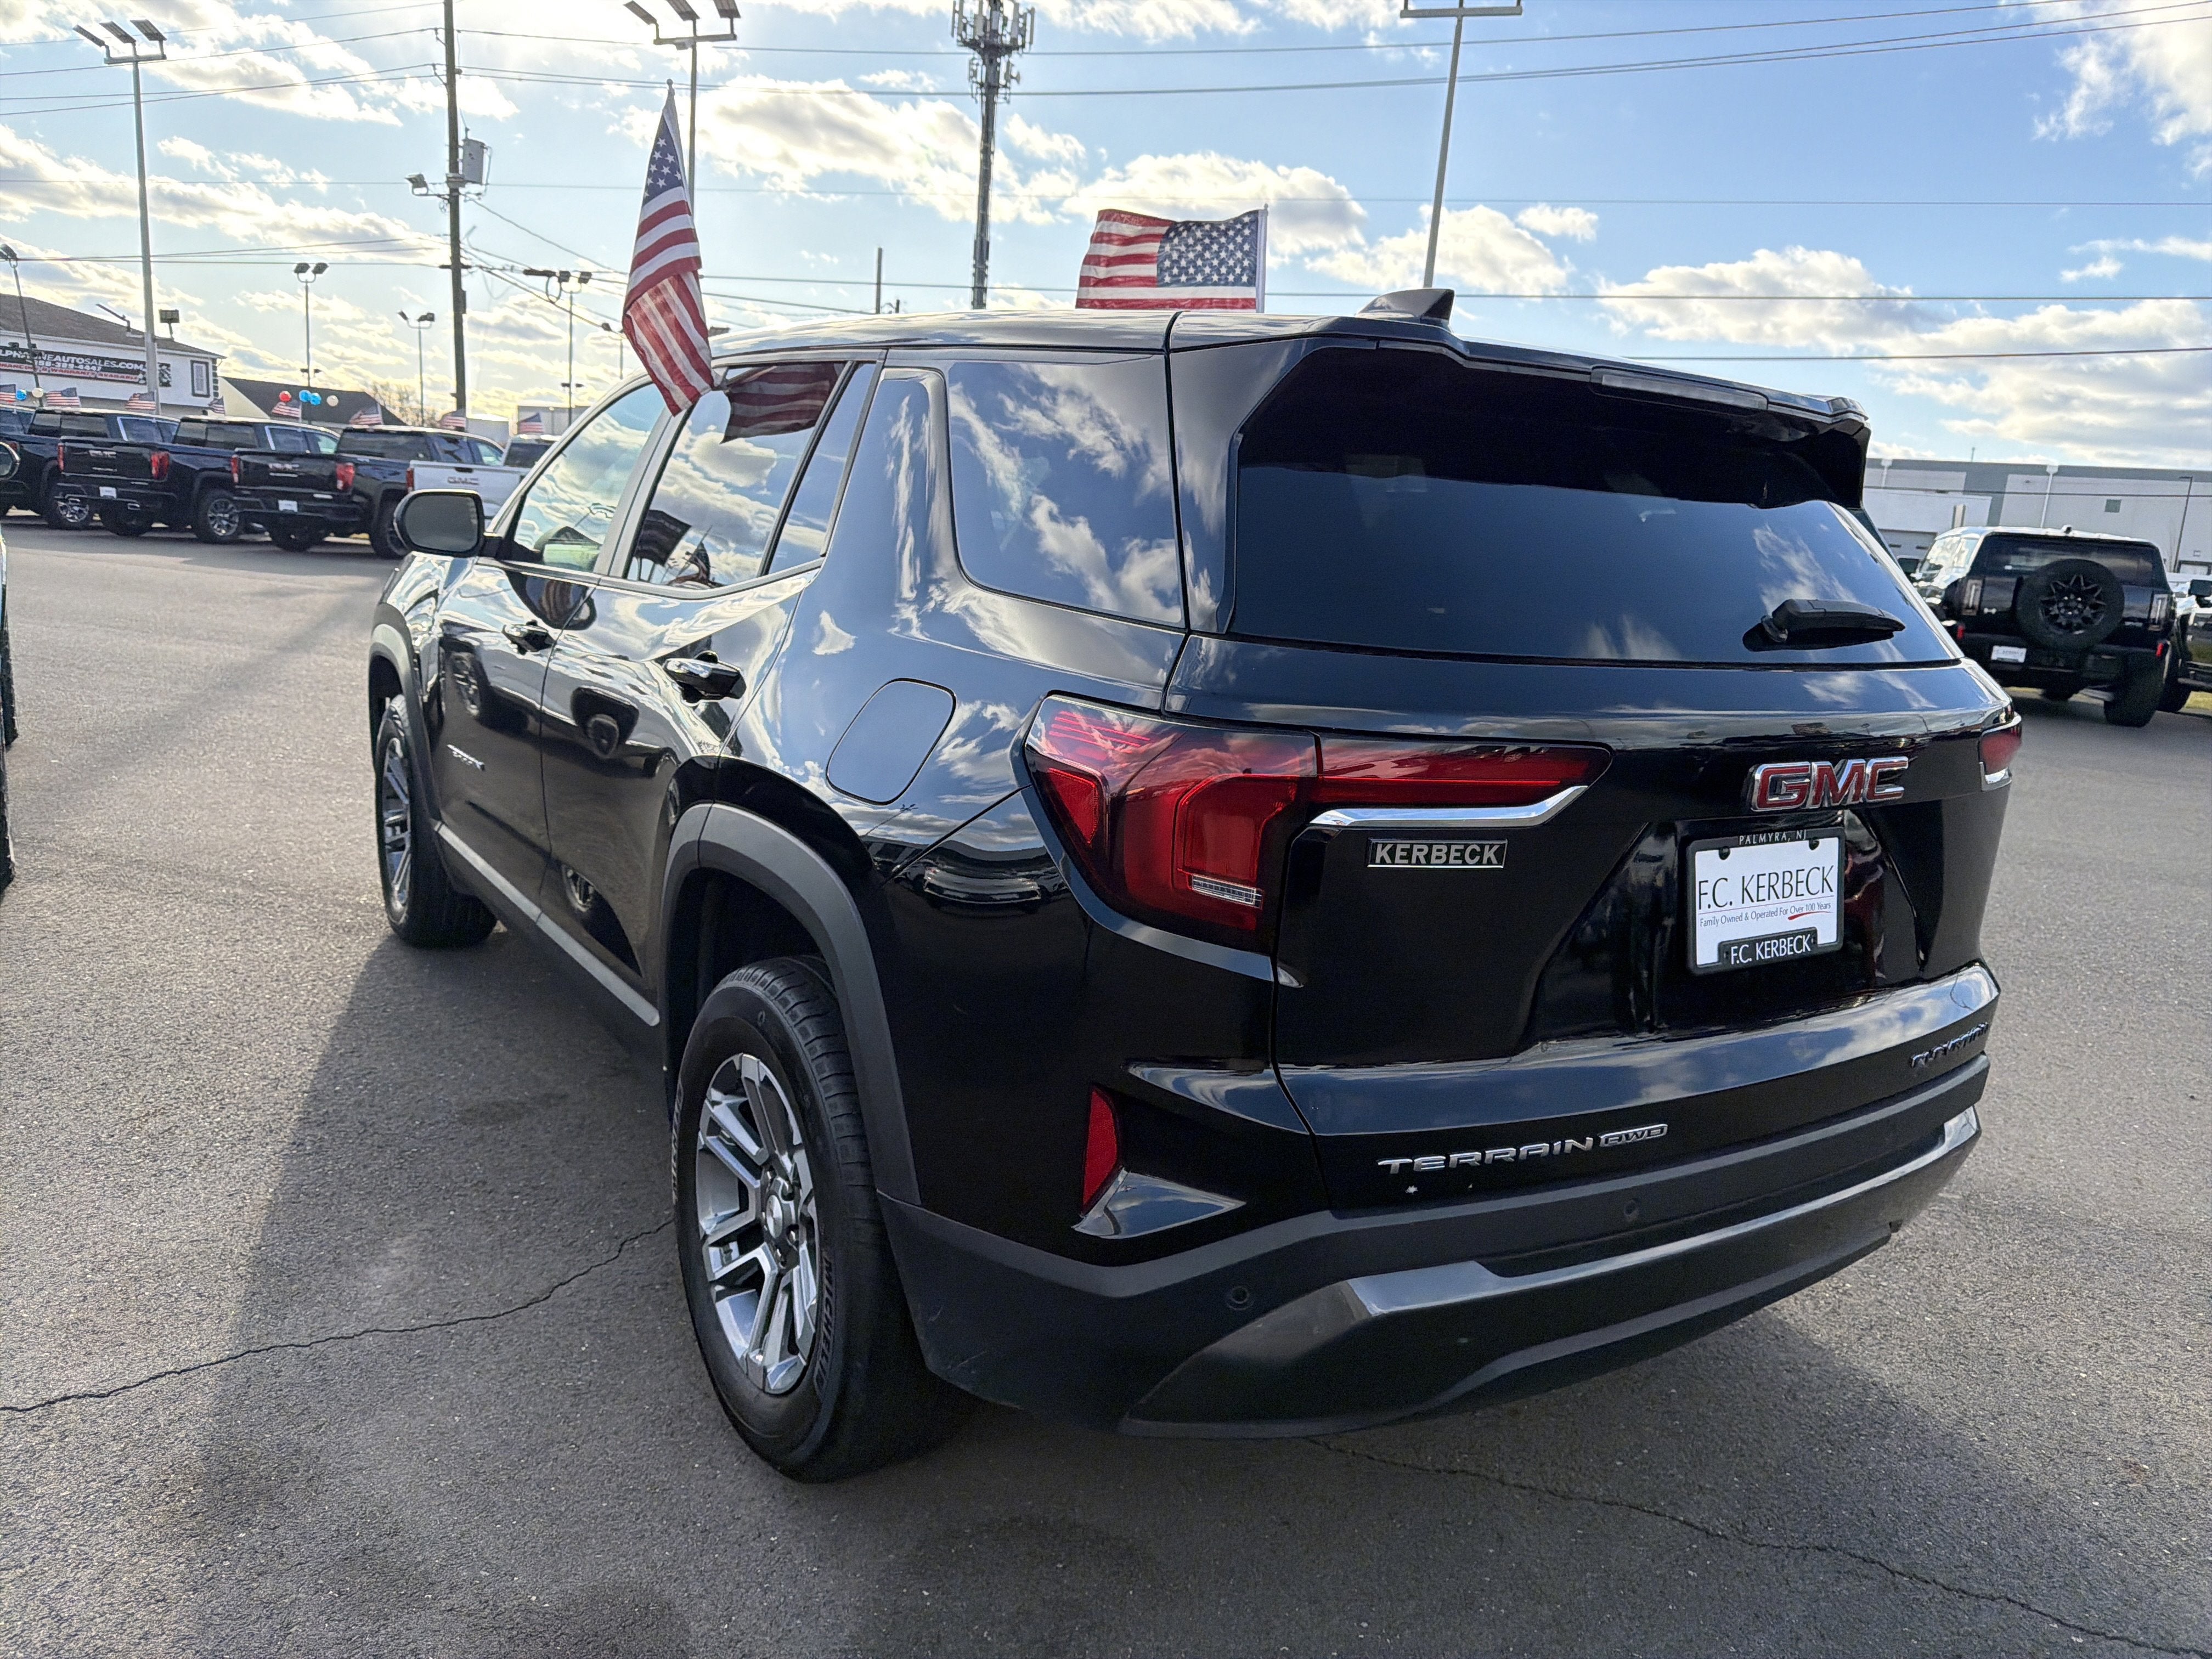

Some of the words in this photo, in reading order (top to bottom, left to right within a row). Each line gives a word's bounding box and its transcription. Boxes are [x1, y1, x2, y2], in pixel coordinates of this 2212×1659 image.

[1751, 756, 1909, 812] GMC
[1739, 831, 1791, 845] PALMYRA,
[1796, 829, 1807, 840] NJ
[1375, 843, 1500, 865] KERBECK
[1698, 877, 1733, 910] F.C.
[1741, 865, 1835, 905] KERBECK
[1700, 916, 1719, 928] Family
[1720, 912, 1743, 925] Owned
[1751, 909, 1779, 923] Operated
[1779, 906, 1789, 916] For
[1790, 904, 1804, 915] Over
[1805, 902, 1816, 912] 100
[1817, 901, 1832, 910] Years
[1731, 944, 1752, 965] F.C.
[1756, 934, 1812, 961] KERBECK
[1377, 1137, 1594, 1175] TERRAIN
[1598, 1124, 1668, 1147] AWD
